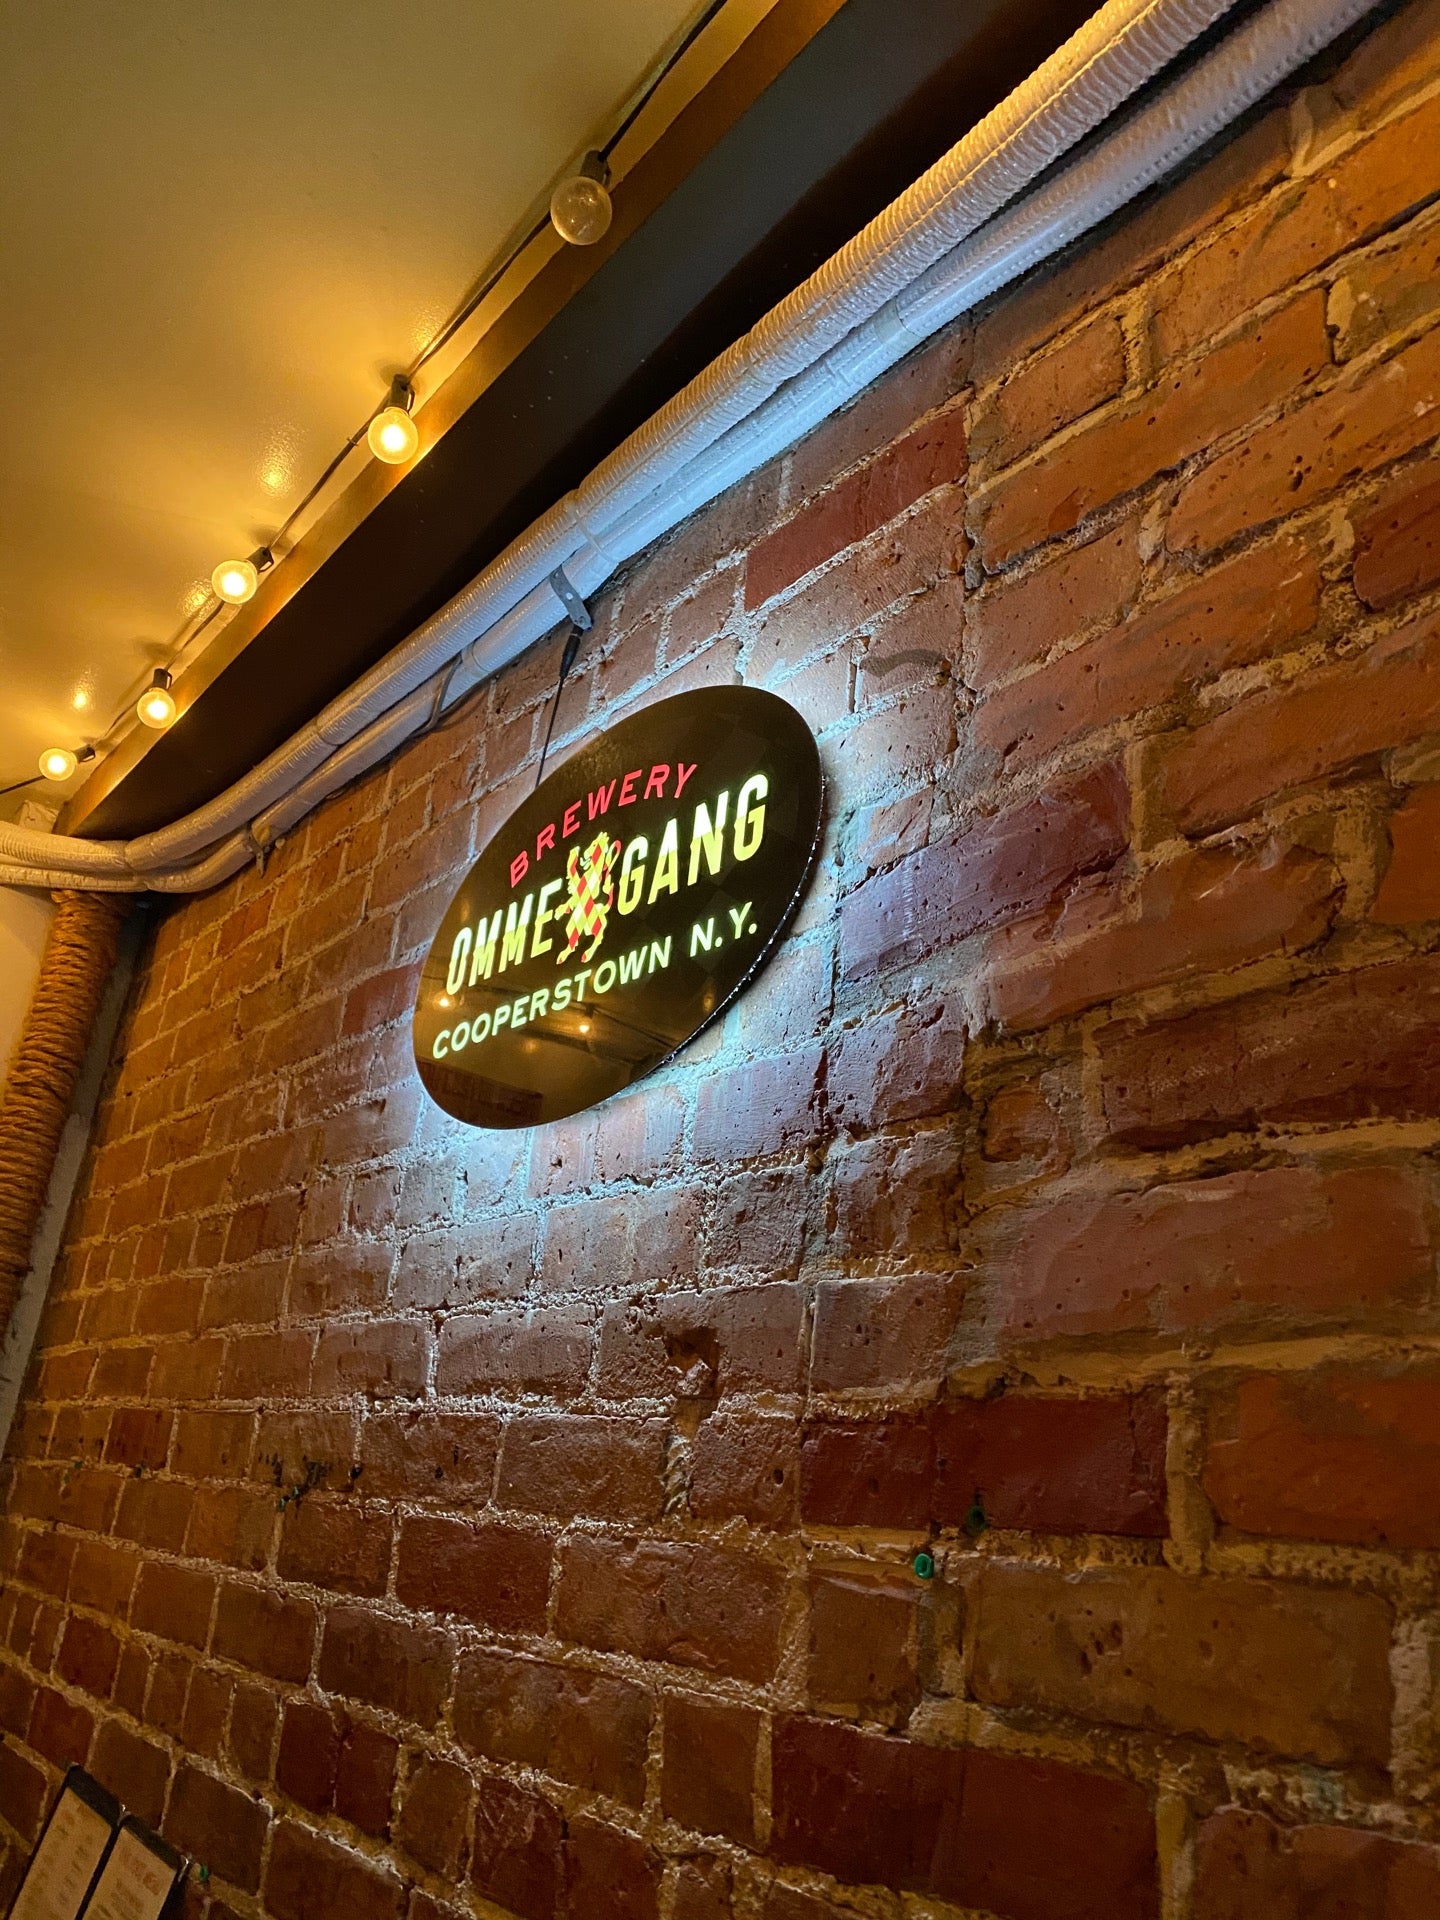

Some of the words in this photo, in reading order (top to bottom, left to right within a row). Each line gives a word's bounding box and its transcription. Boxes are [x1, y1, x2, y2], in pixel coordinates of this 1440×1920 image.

[510, 762, 698, 888] BREWERY
[432, 936, 672, 1059] COOPERSTOWN
[688, 901, 758, 958] N.Y.
